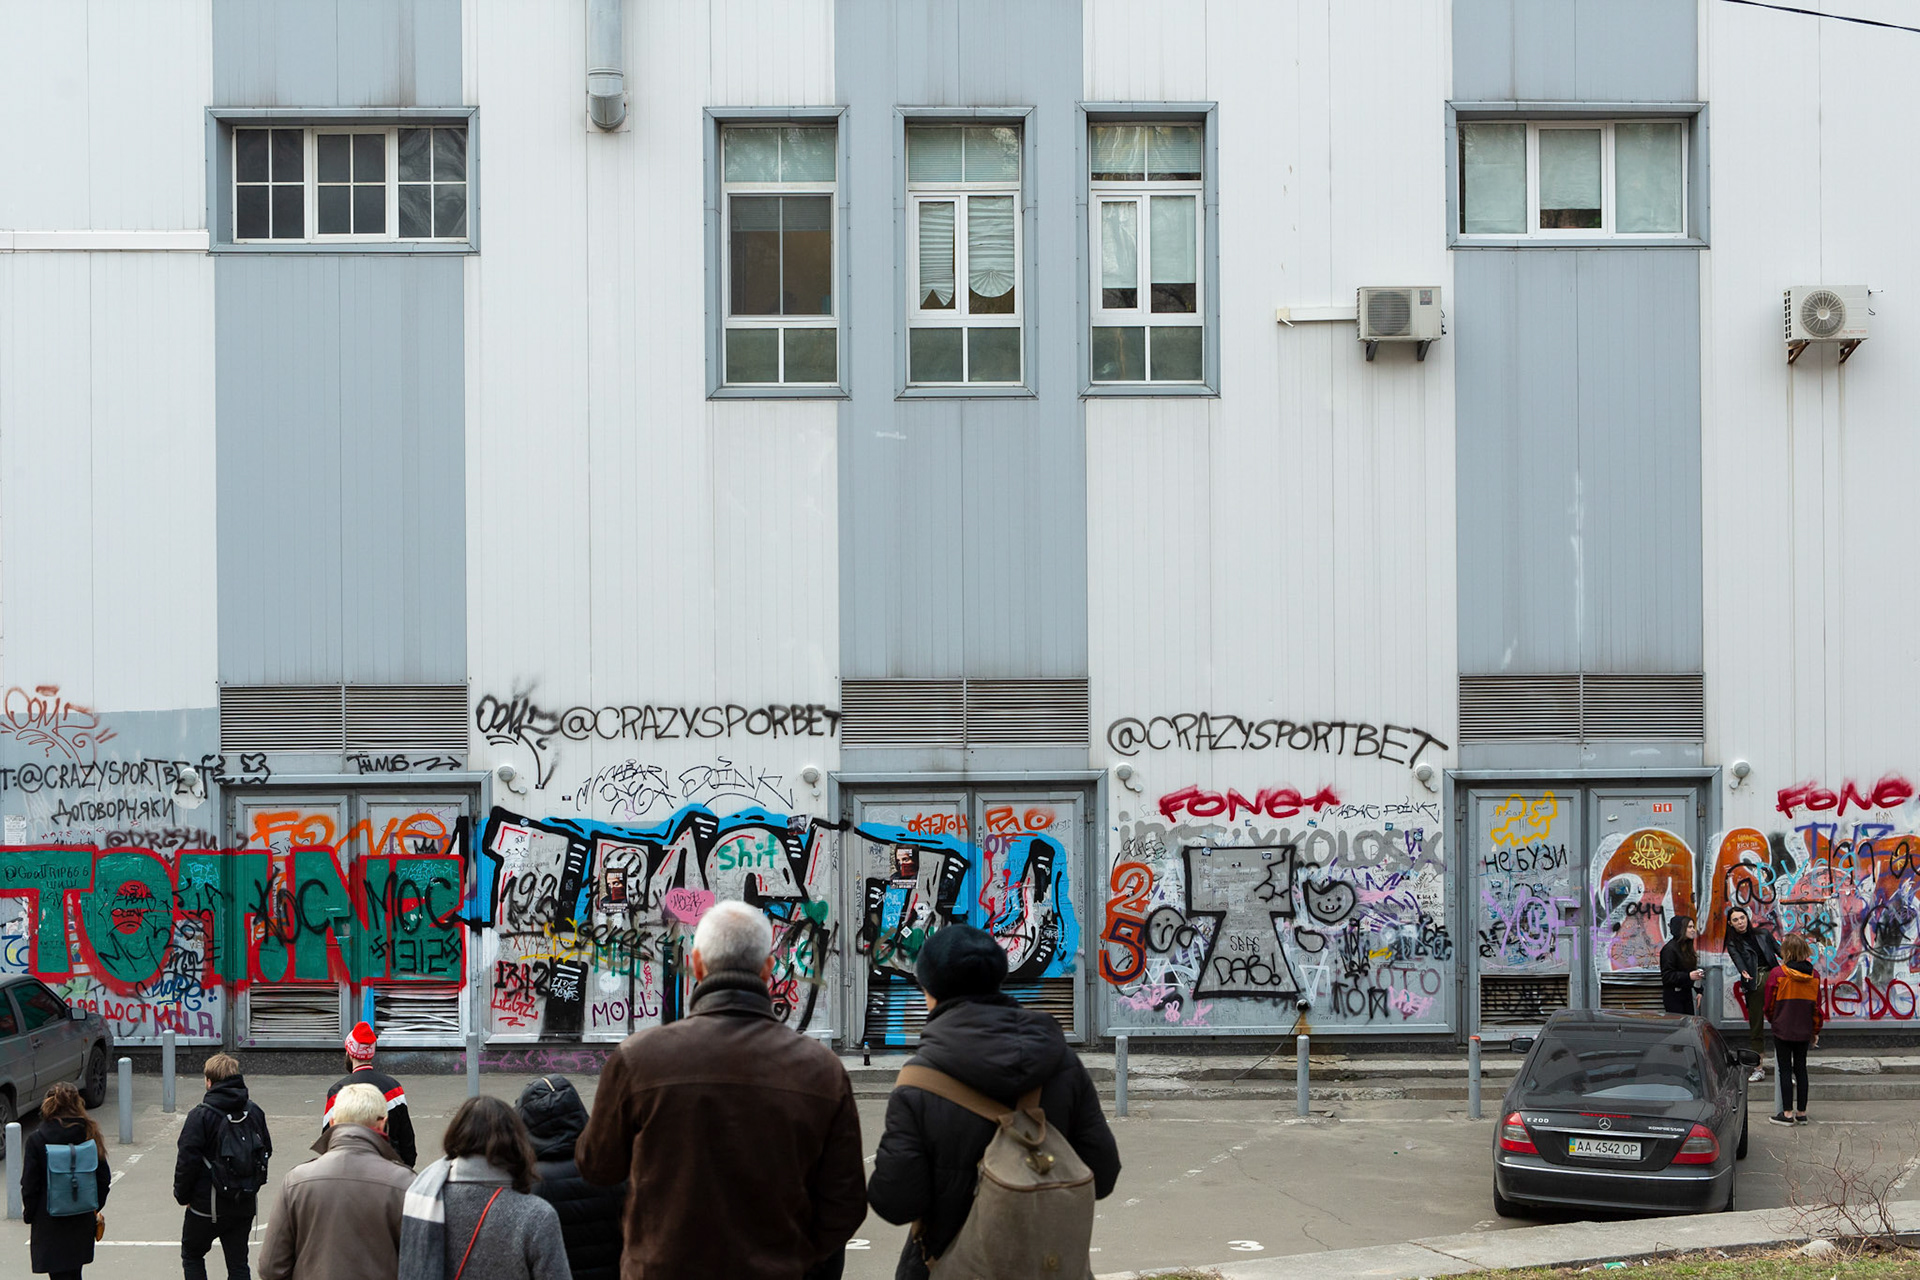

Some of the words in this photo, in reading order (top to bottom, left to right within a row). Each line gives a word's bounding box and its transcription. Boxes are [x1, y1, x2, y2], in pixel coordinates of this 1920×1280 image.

[560, 704, 842, 740] @CRAZYSPORBET
[1107, 711, 1450, 769] @CRAZYSPORTBET
[51, 798, 176, 827] ДОГОВОРНЯКИ
[391, 938, 449, 975] 1312
[1577, 1141, 1592, 1152] AA
[1595, 1142, 1620, 1155] 4542
[1227, 1240, 1264, 1252] 3
